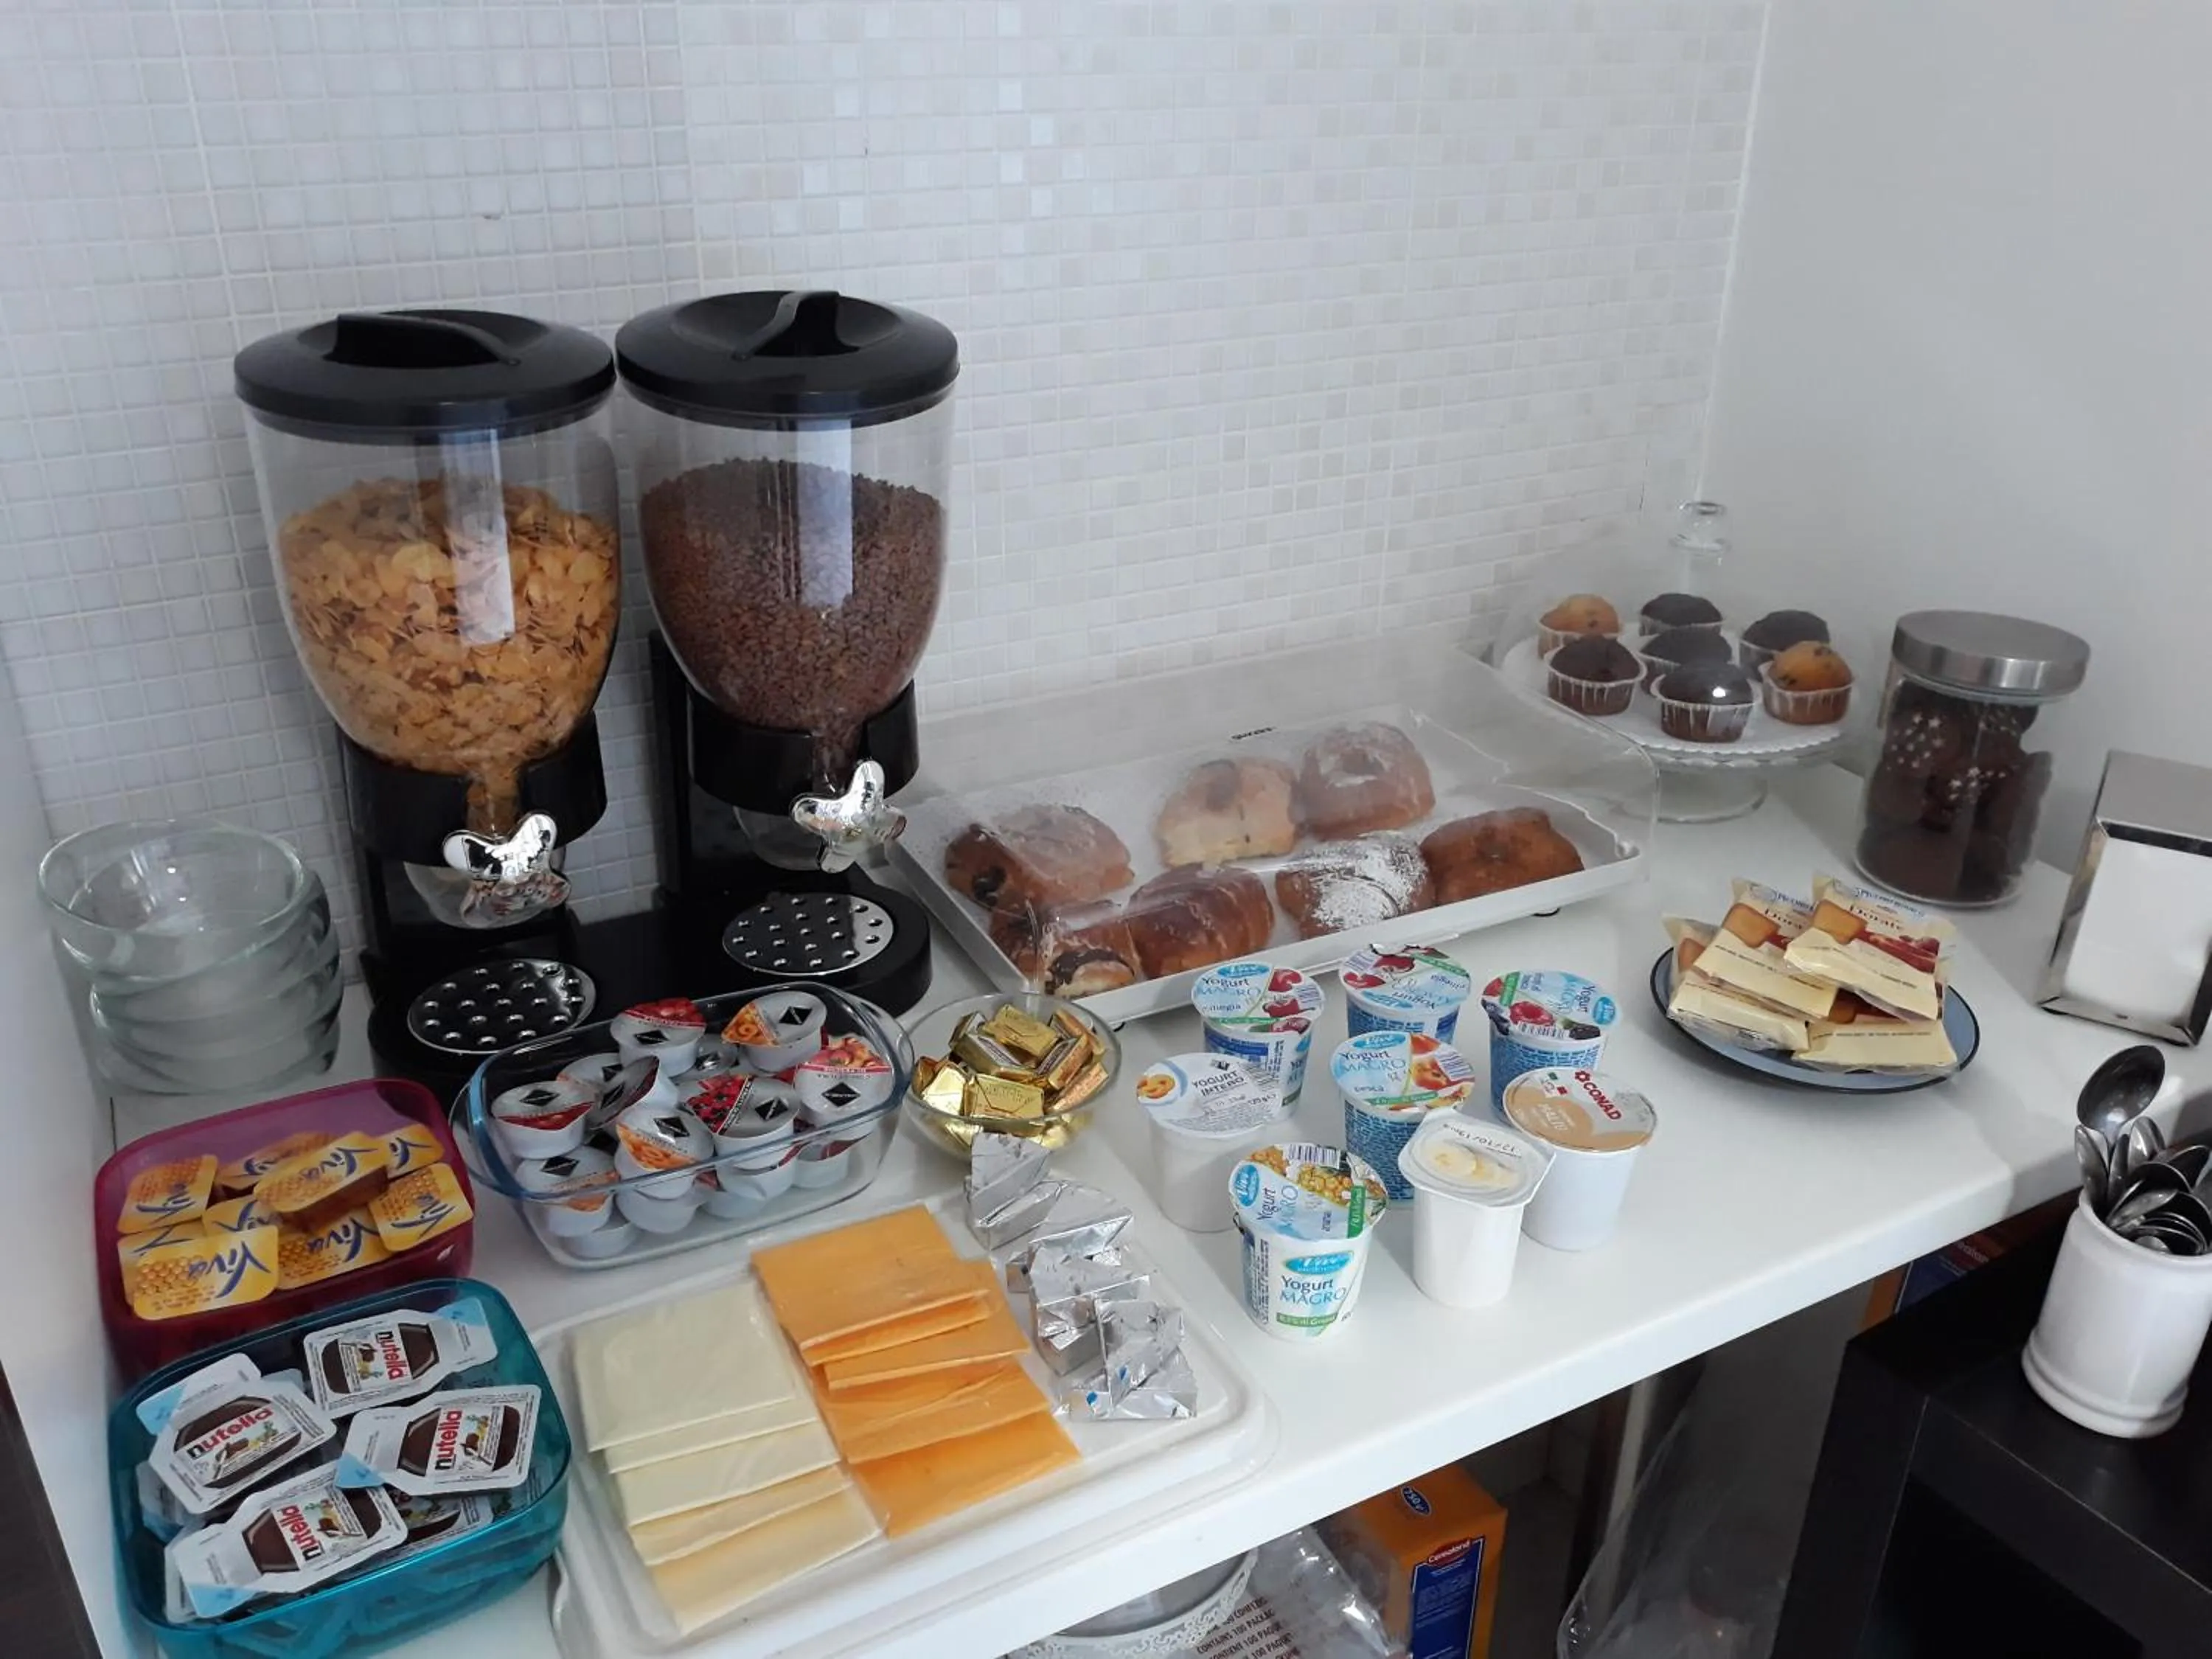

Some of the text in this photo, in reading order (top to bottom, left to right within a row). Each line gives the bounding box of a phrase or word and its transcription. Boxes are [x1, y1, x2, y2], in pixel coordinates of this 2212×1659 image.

[1201, 977, 1250, 988] Yogurt
[1338, 1051, 1391, 1062] Yogurt
[1192, 1069, 1239, 1088] YOGURT
[1200, 1077, 1245, 1097] INTERO
[1583, 1082, 1622, 1121] CONAD
[302, 1147, 380, 1181] Viva
[1256, 1186, 1278, 1221] Yogurt
[307, 1217, 382, 1262] Viva
[188, 1239, 271, 1300] Viva
[1281, 1275, 1334, 1294] Yogurt
[1279, 1287, 1347, 1306] MAGRO
[375, 1330, 406, 1381] nutella
[186, 1407, 274, 1460] nutella
[434, 1409, 463, 1470] nutella
[280, 1506, 324, 1562] nutella
